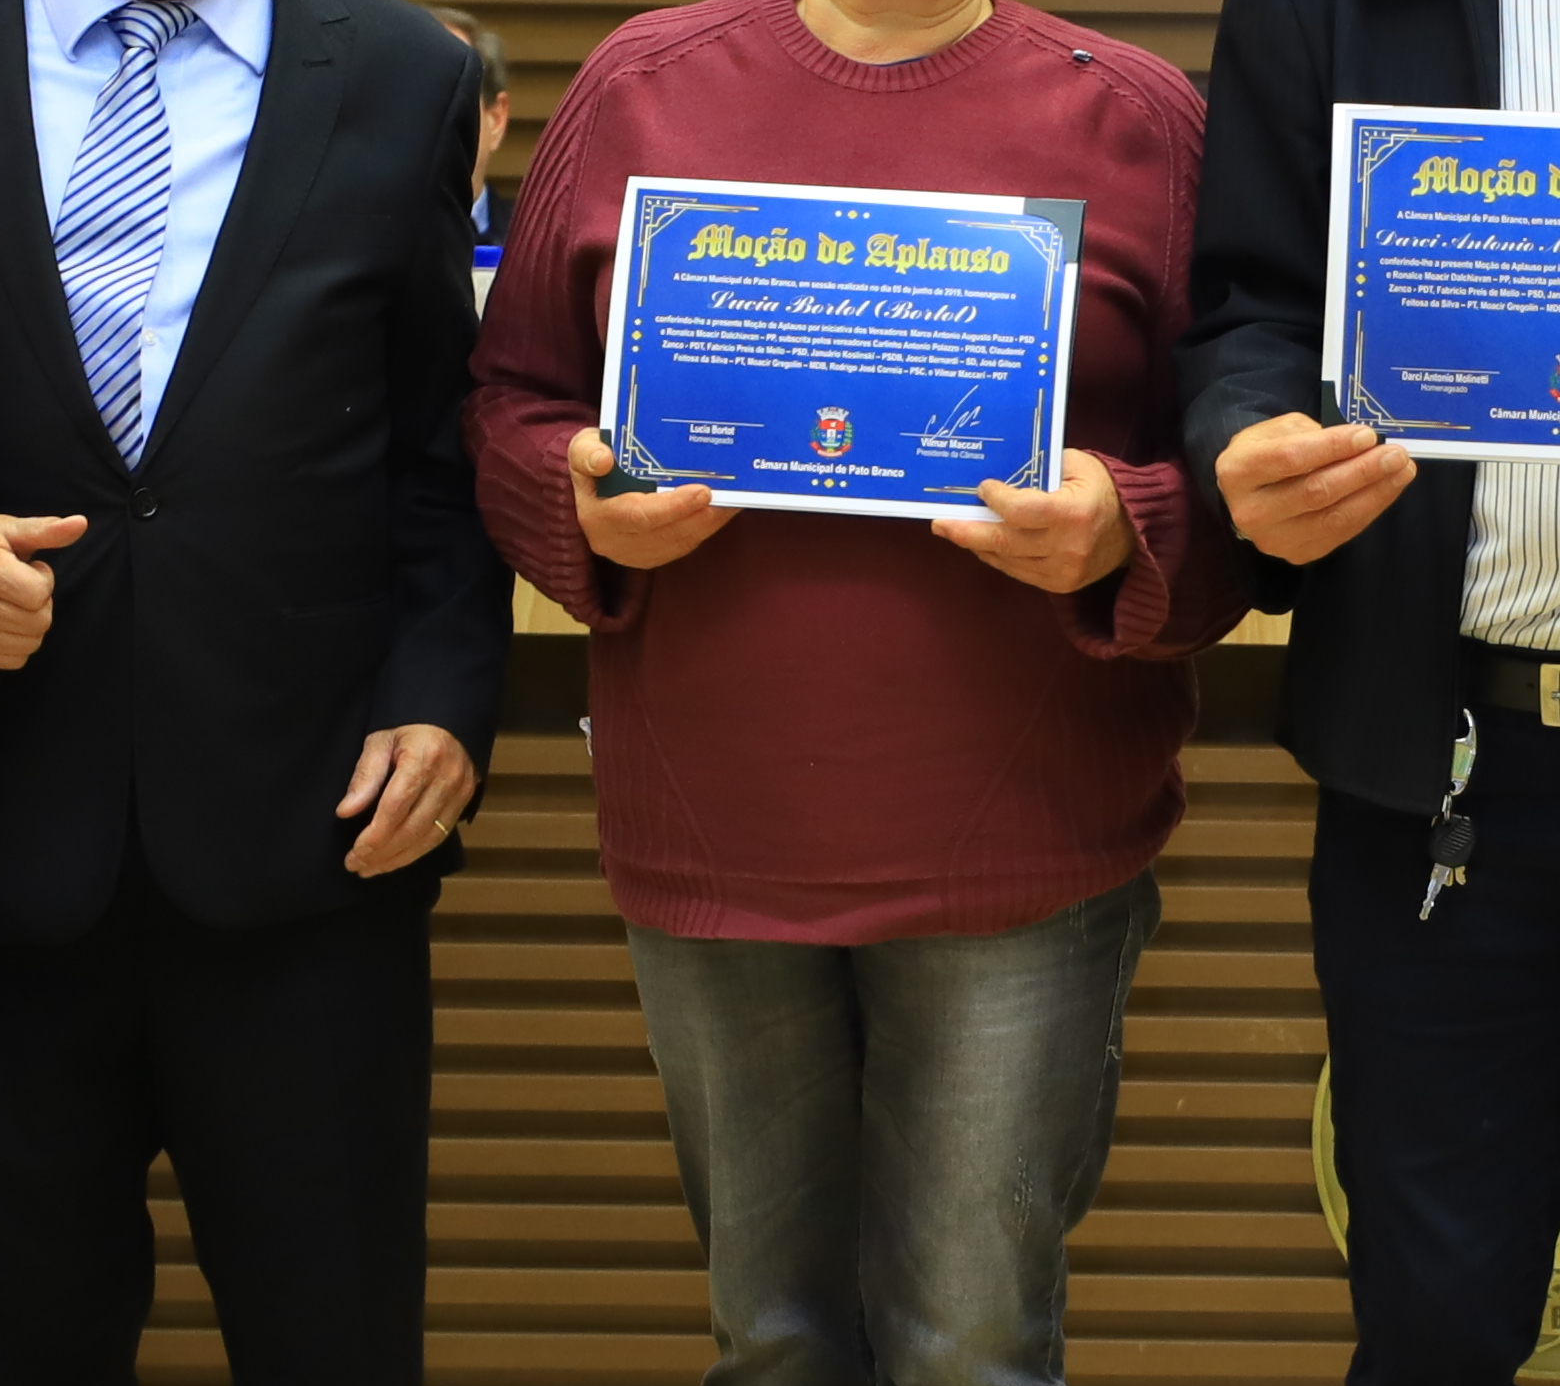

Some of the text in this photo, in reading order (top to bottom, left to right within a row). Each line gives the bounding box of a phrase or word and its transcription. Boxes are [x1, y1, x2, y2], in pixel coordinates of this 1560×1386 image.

[1410, 155, 1537, 204] Moção
[687, 223, 1012, 275] Moção de Aplauso
[1489, 407, 1527, 420] Câmara
[920, 437, 983, 450] Vilmar Maccari
[752, 458, 905, 478] Câmara Municipal de Pato Branco
